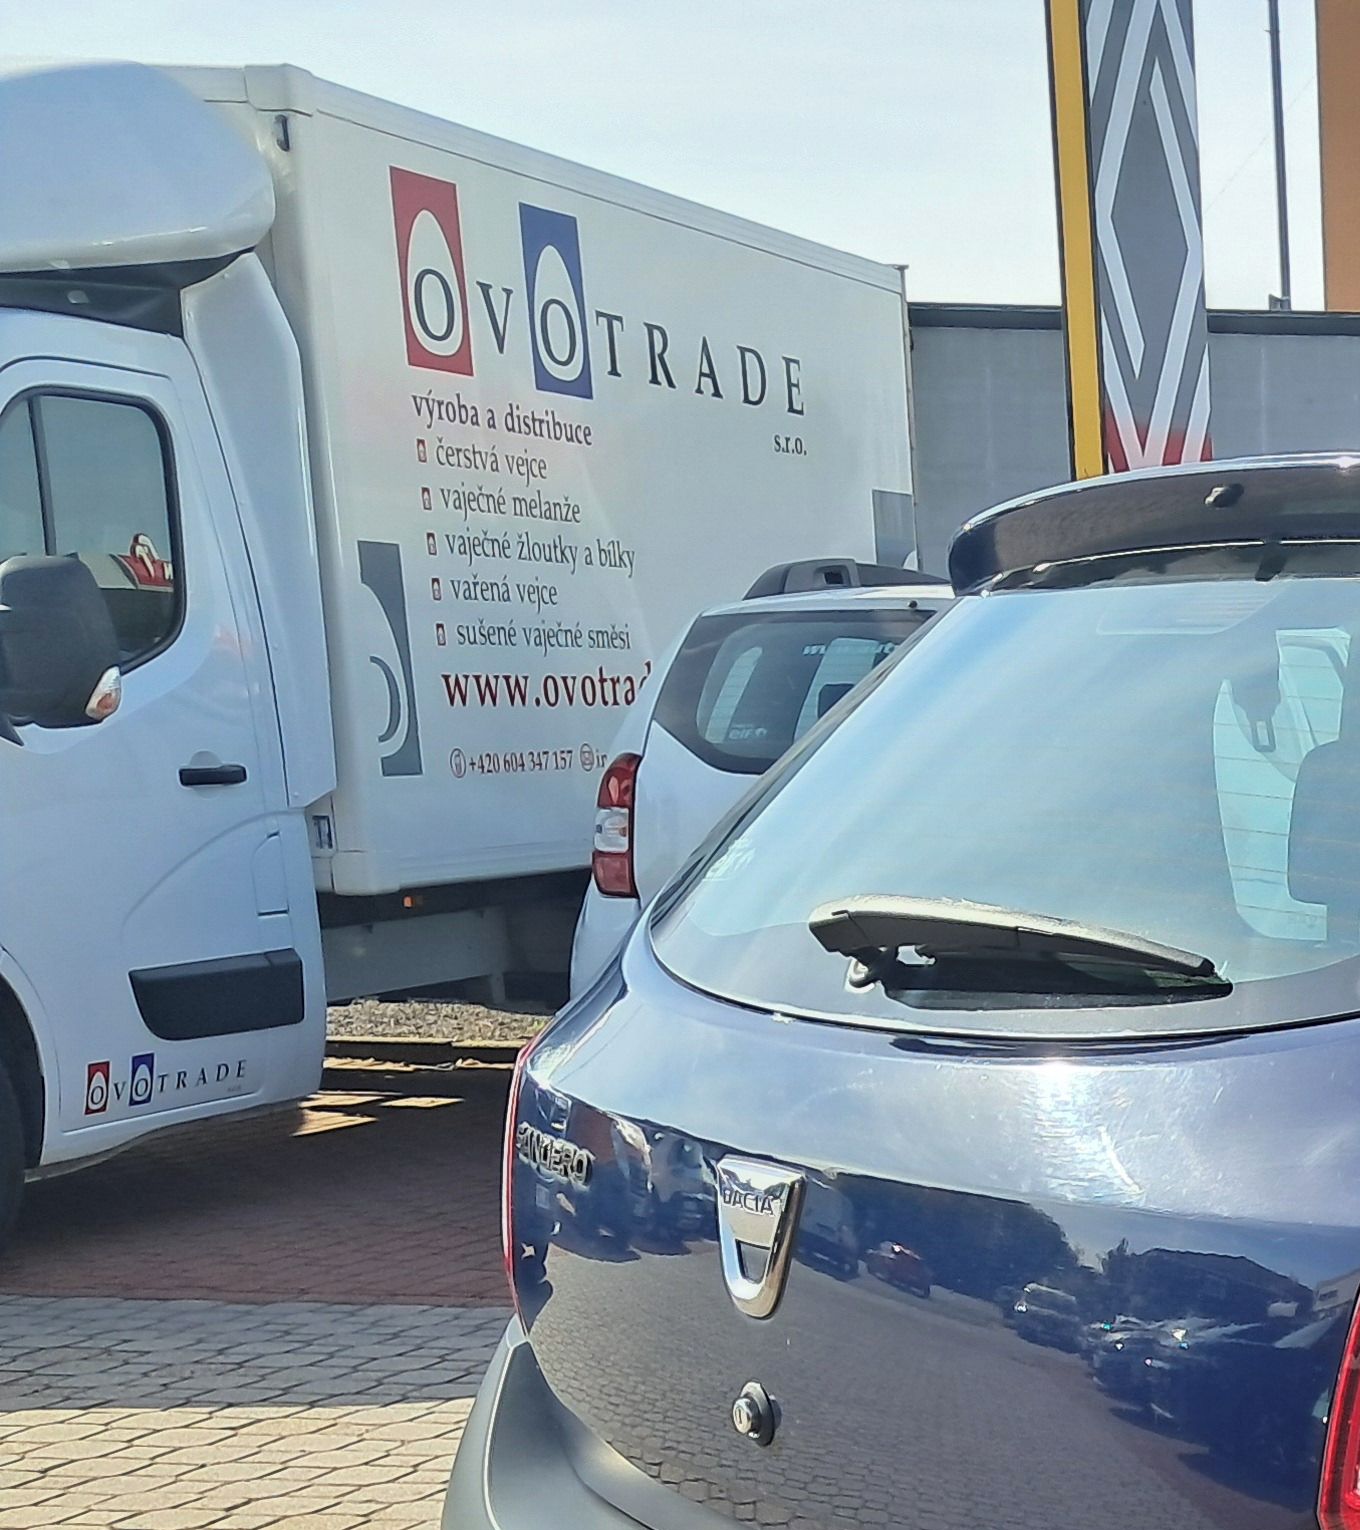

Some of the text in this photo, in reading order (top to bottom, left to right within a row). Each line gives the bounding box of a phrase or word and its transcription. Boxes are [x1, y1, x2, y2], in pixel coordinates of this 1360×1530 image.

[412, 389, 593, 446] výroba a distribuce
[436, 436, 547, 487] čerstvá vejce
[773, 434, 808, 456] s.r.o.
[440, 483, 581, 523] vaječné melanže
[444, 527, 635, 578] vaječné žloutky a bílky
[450, 573, 558, 614] vařená vejce
[457, 620, 631, 657] sušené vaječné směsi
[469, 752, 500, 774] +420
[503, 752, 526, 772] 604
[528, 751, 549, 771] 347
[554, 750, 573, 770] 157
[723, 1188, 773, 1215] DACIA
